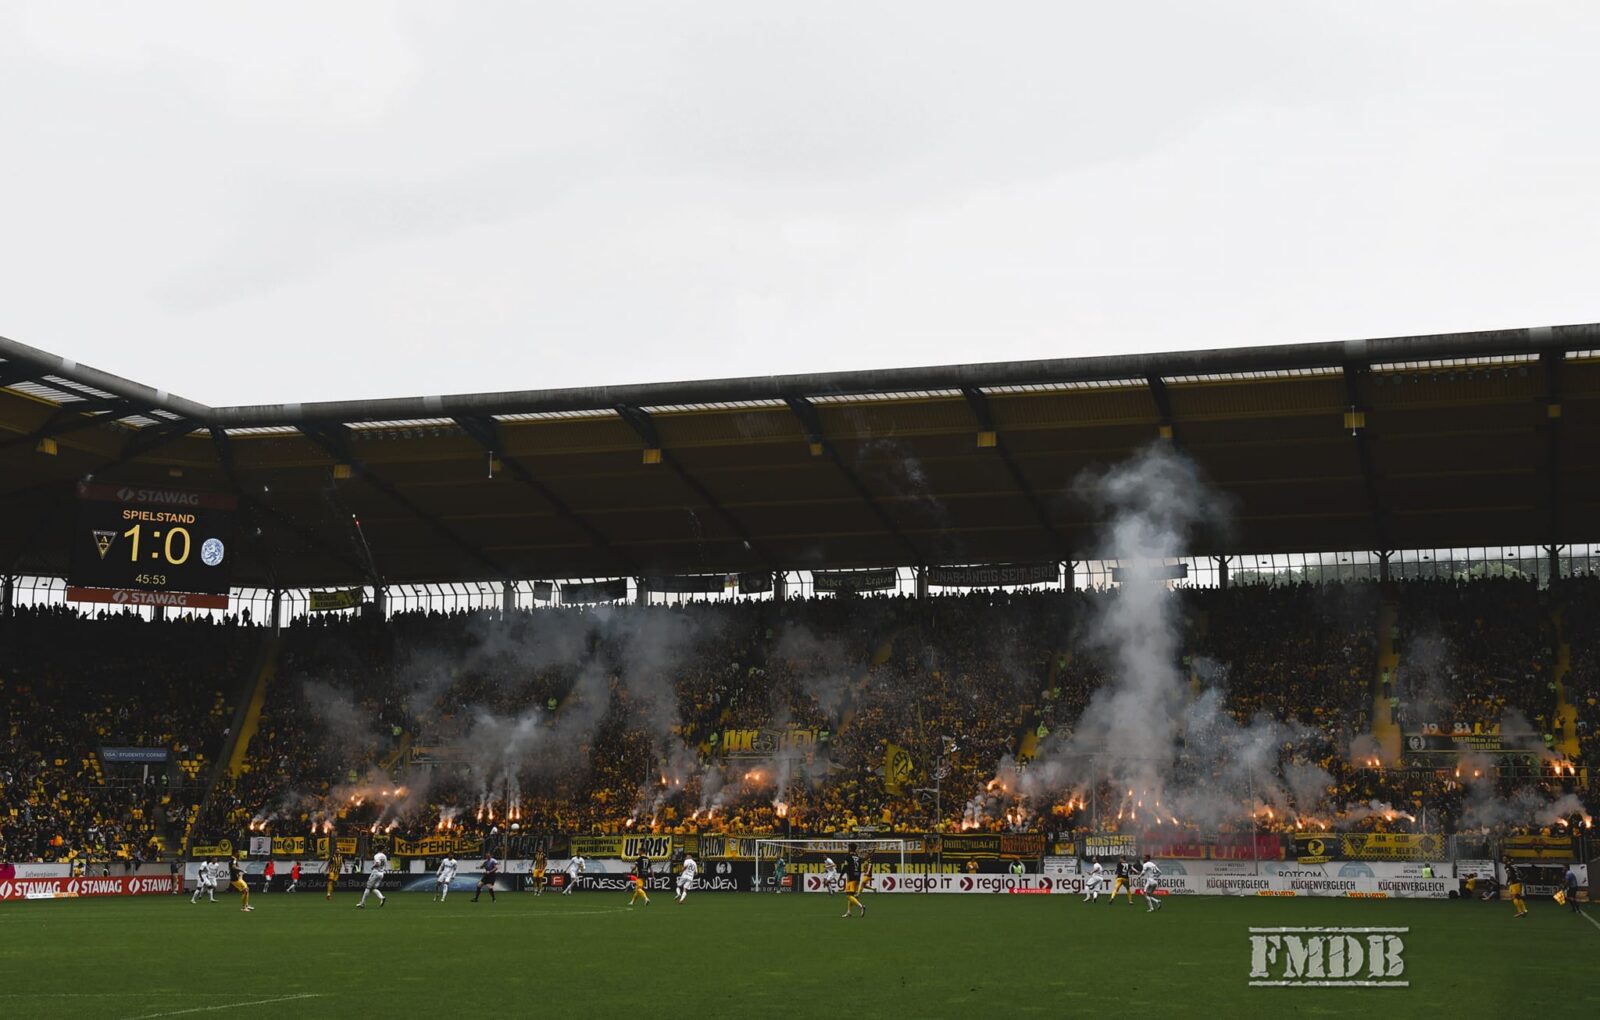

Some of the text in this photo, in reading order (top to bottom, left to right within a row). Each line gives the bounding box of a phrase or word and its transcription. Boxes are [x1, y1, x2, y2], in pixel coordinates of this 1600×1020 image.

[137, 489, 199, 505] STAWAG
[122, 510, 195, 524] SPIELSTAND
[124, 524, 191, 565] 1:0
[135, 574, 166, 585] 45:53
[131, 593, 187, 606] STAWAG
[625, 838, 670, 857] ULTRAS
[1085, 846, 1136, 857] HOOLIGANS
[15, 881, 61, 897] STAWAG
[81, 880, 123, 894] STAWAG
[142, 878, 179, 892] STAWA
[576, 876, 626, 889] FITNESS
[676, 876, 737, 890] FEUNDEN
[899, 875, 937, 893] regio
[977, 875, 1015, 893] regio
[1206, 877, 1269, 889] KÜCHENVERGLEICH
[1291, 878, 1355, 890] KÜCHENVERGLEICH
[1378, 880, 1445, 891] KÜCHENVERGLEICH
